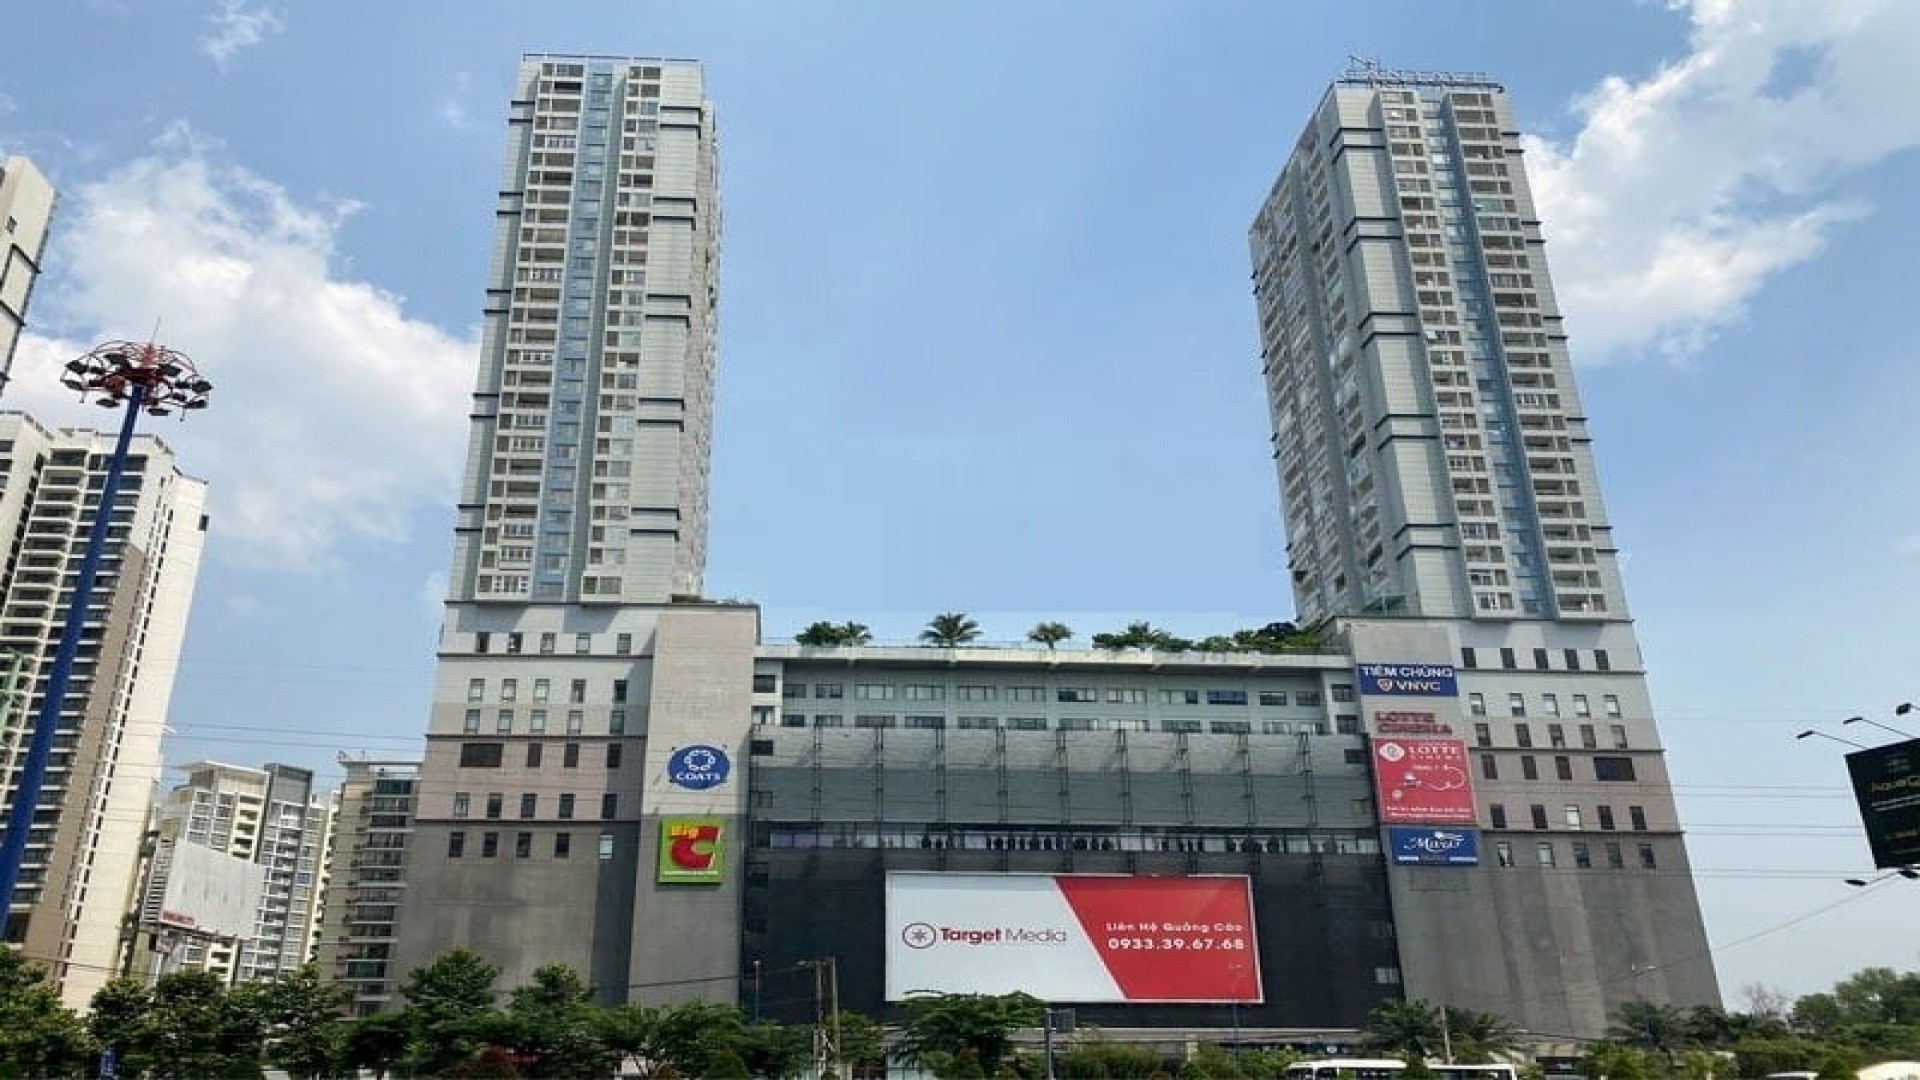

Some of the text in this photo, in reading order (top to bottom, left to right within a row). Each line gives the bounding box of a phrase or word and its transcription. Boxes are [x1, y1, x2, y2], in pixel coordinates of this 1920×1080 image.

[1397, 681, 1440, 691] VNVC
[676, 772, 720, 780] COATS
[941, 926, 1067, 943] Target Media
